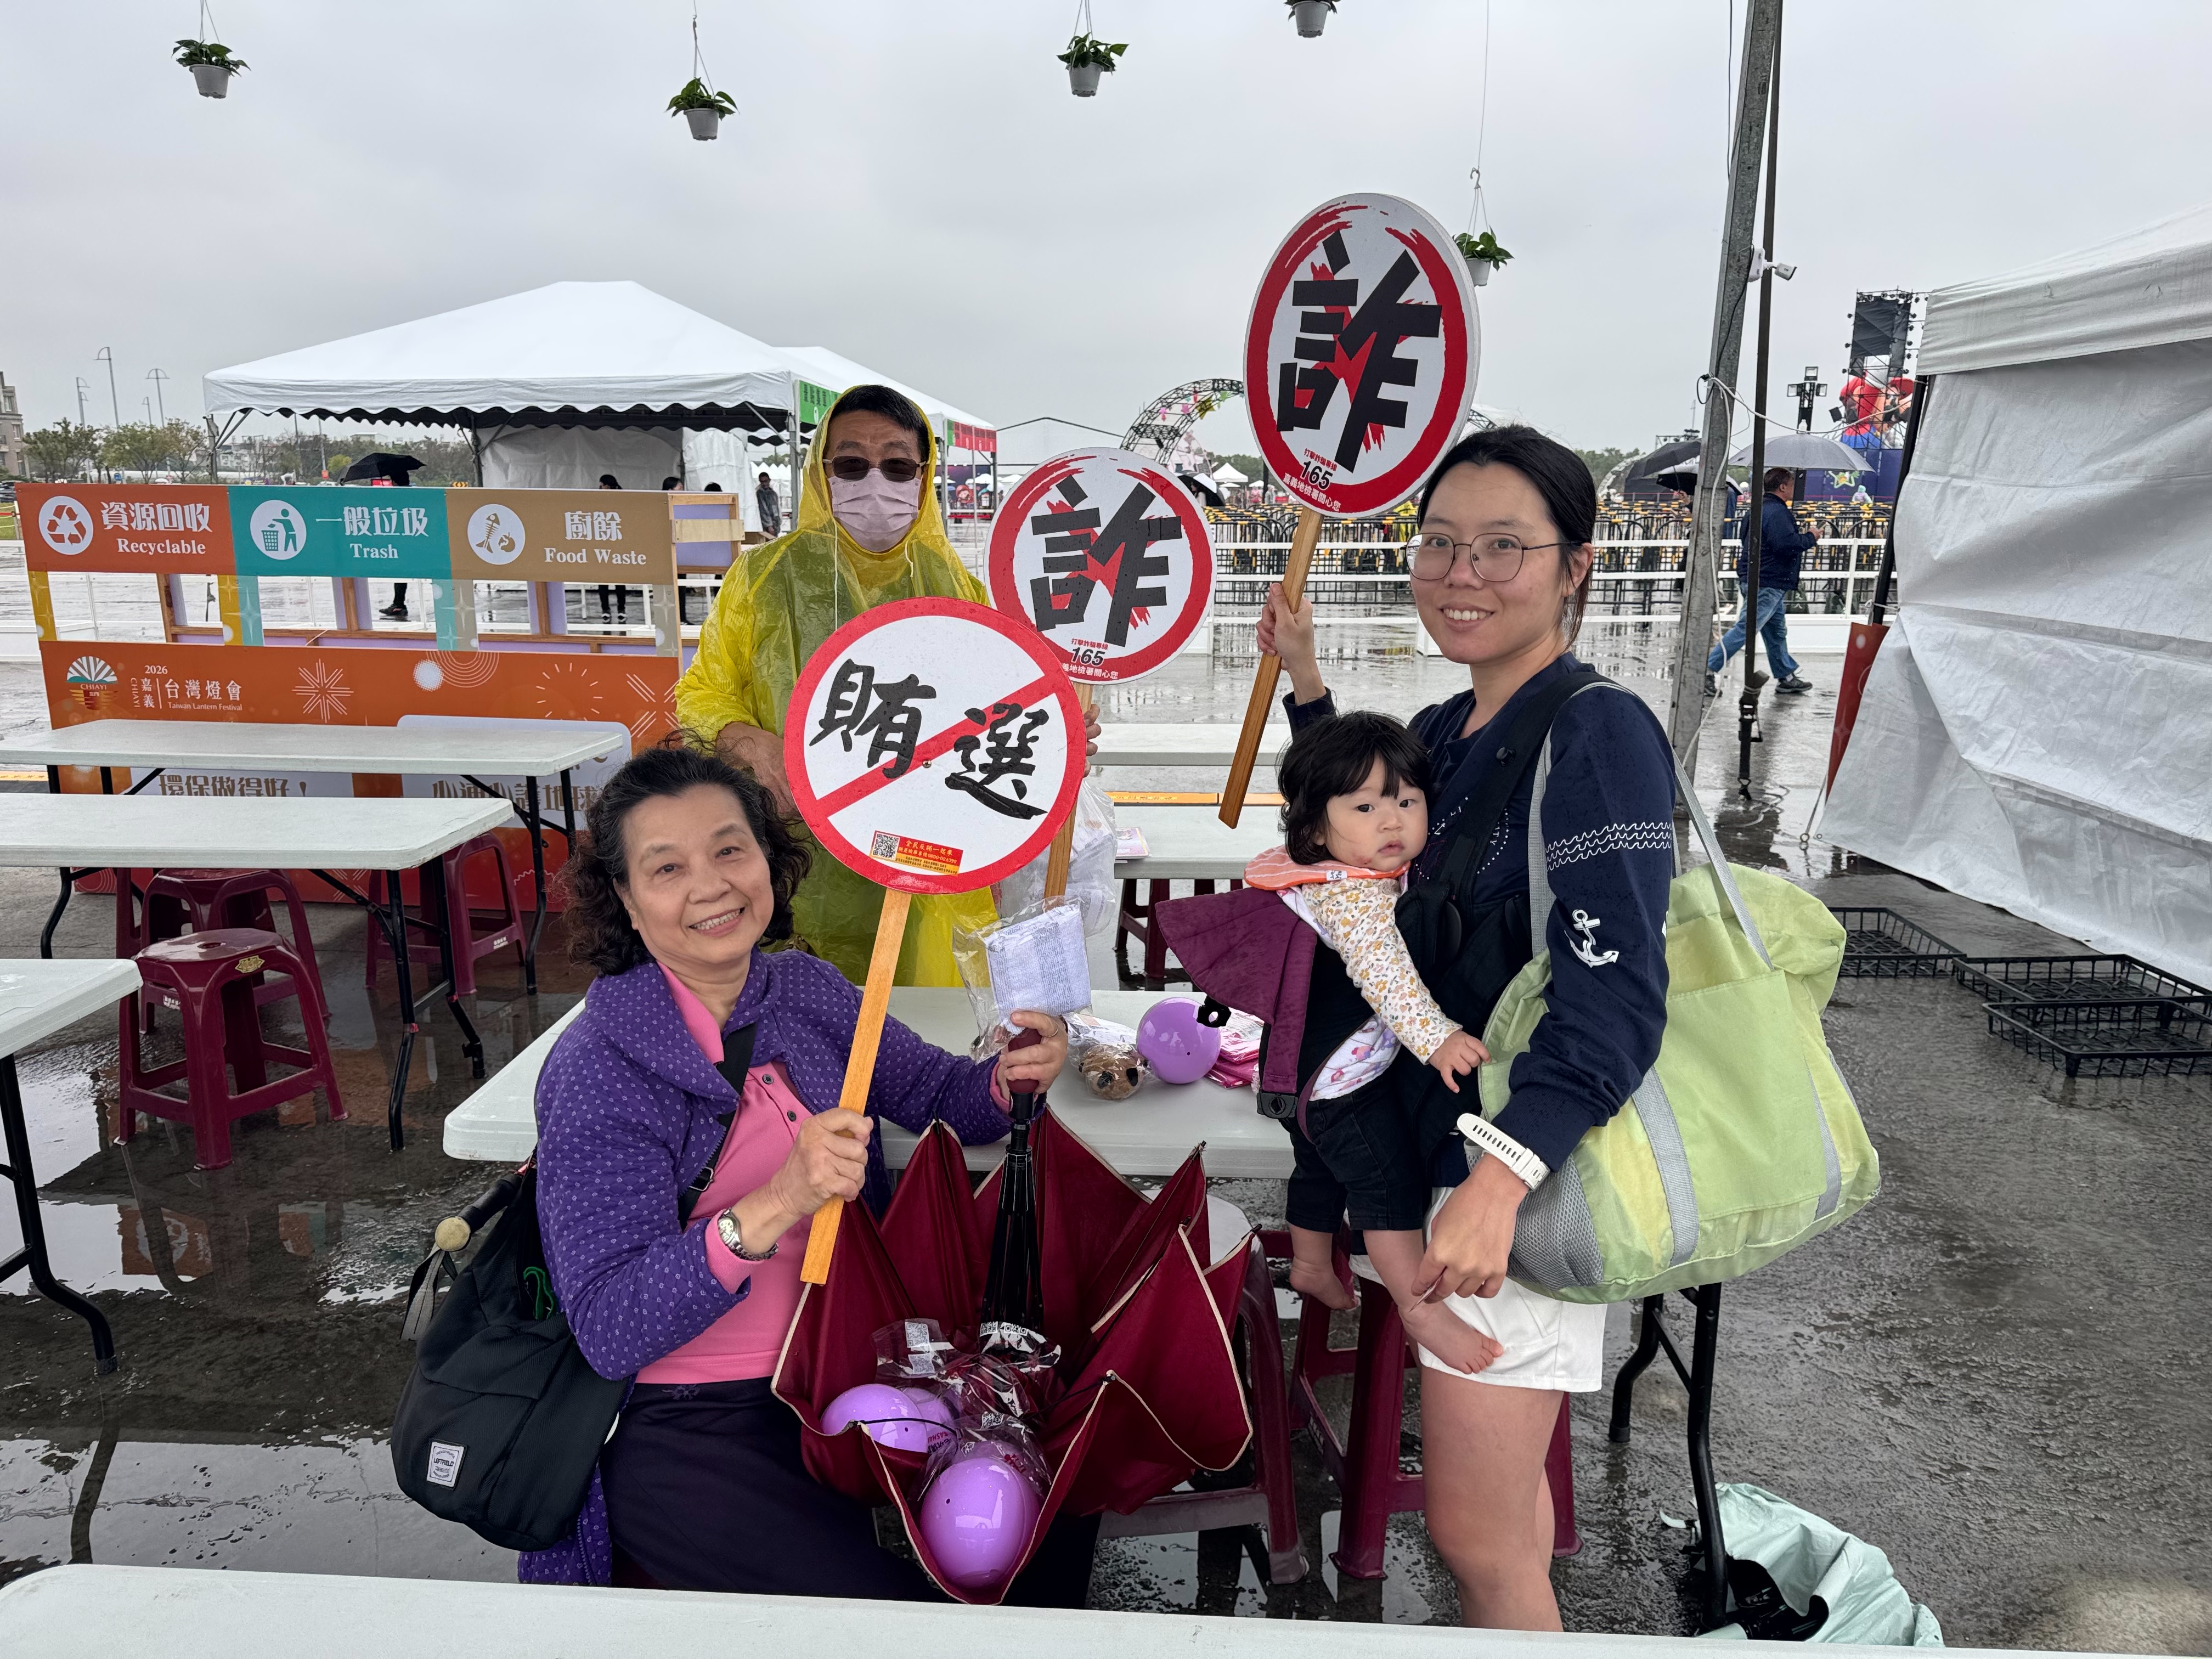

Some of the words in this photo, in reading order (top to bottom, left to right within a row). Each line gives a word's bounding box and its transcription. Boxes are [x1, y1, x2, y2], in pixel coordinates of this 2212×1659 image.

[1277, 229, 1442, 473] 詐
[1304, 448, 1337, 471] 打擊詐騙專線
[1301, 461, 1333, 490] 165
[1283, 472, 1341, 511] 嘉義地檢署關心您
[101, 502, 213, 533] 資源回收
[315, 506, 430, 537] 一般垃圾
[565, 511, 622, 541] 廚餘
[117, 538, 206, 555] Recyclable
[350, 543, 398, 559] Trash
[545, 548, 587, 564] Food
[595, 550, 646, 565] Waste
[1030, 474, 1182, 647] 詐
[1071, 638, 1108, 650] 打擊詐騙專線
[1072, 647, 1105, 666] 165
[145, 665, 168, 674] 2026
[1062, 663, 1119, 679] 義地檢署關心您
[131, 678, 140, 707] CHIAYI
[141, 678, 155, 708] 嘉義
[165, 679, 241, 701] 台灣燈會
[809, 658, 1048, 820] 賄選
